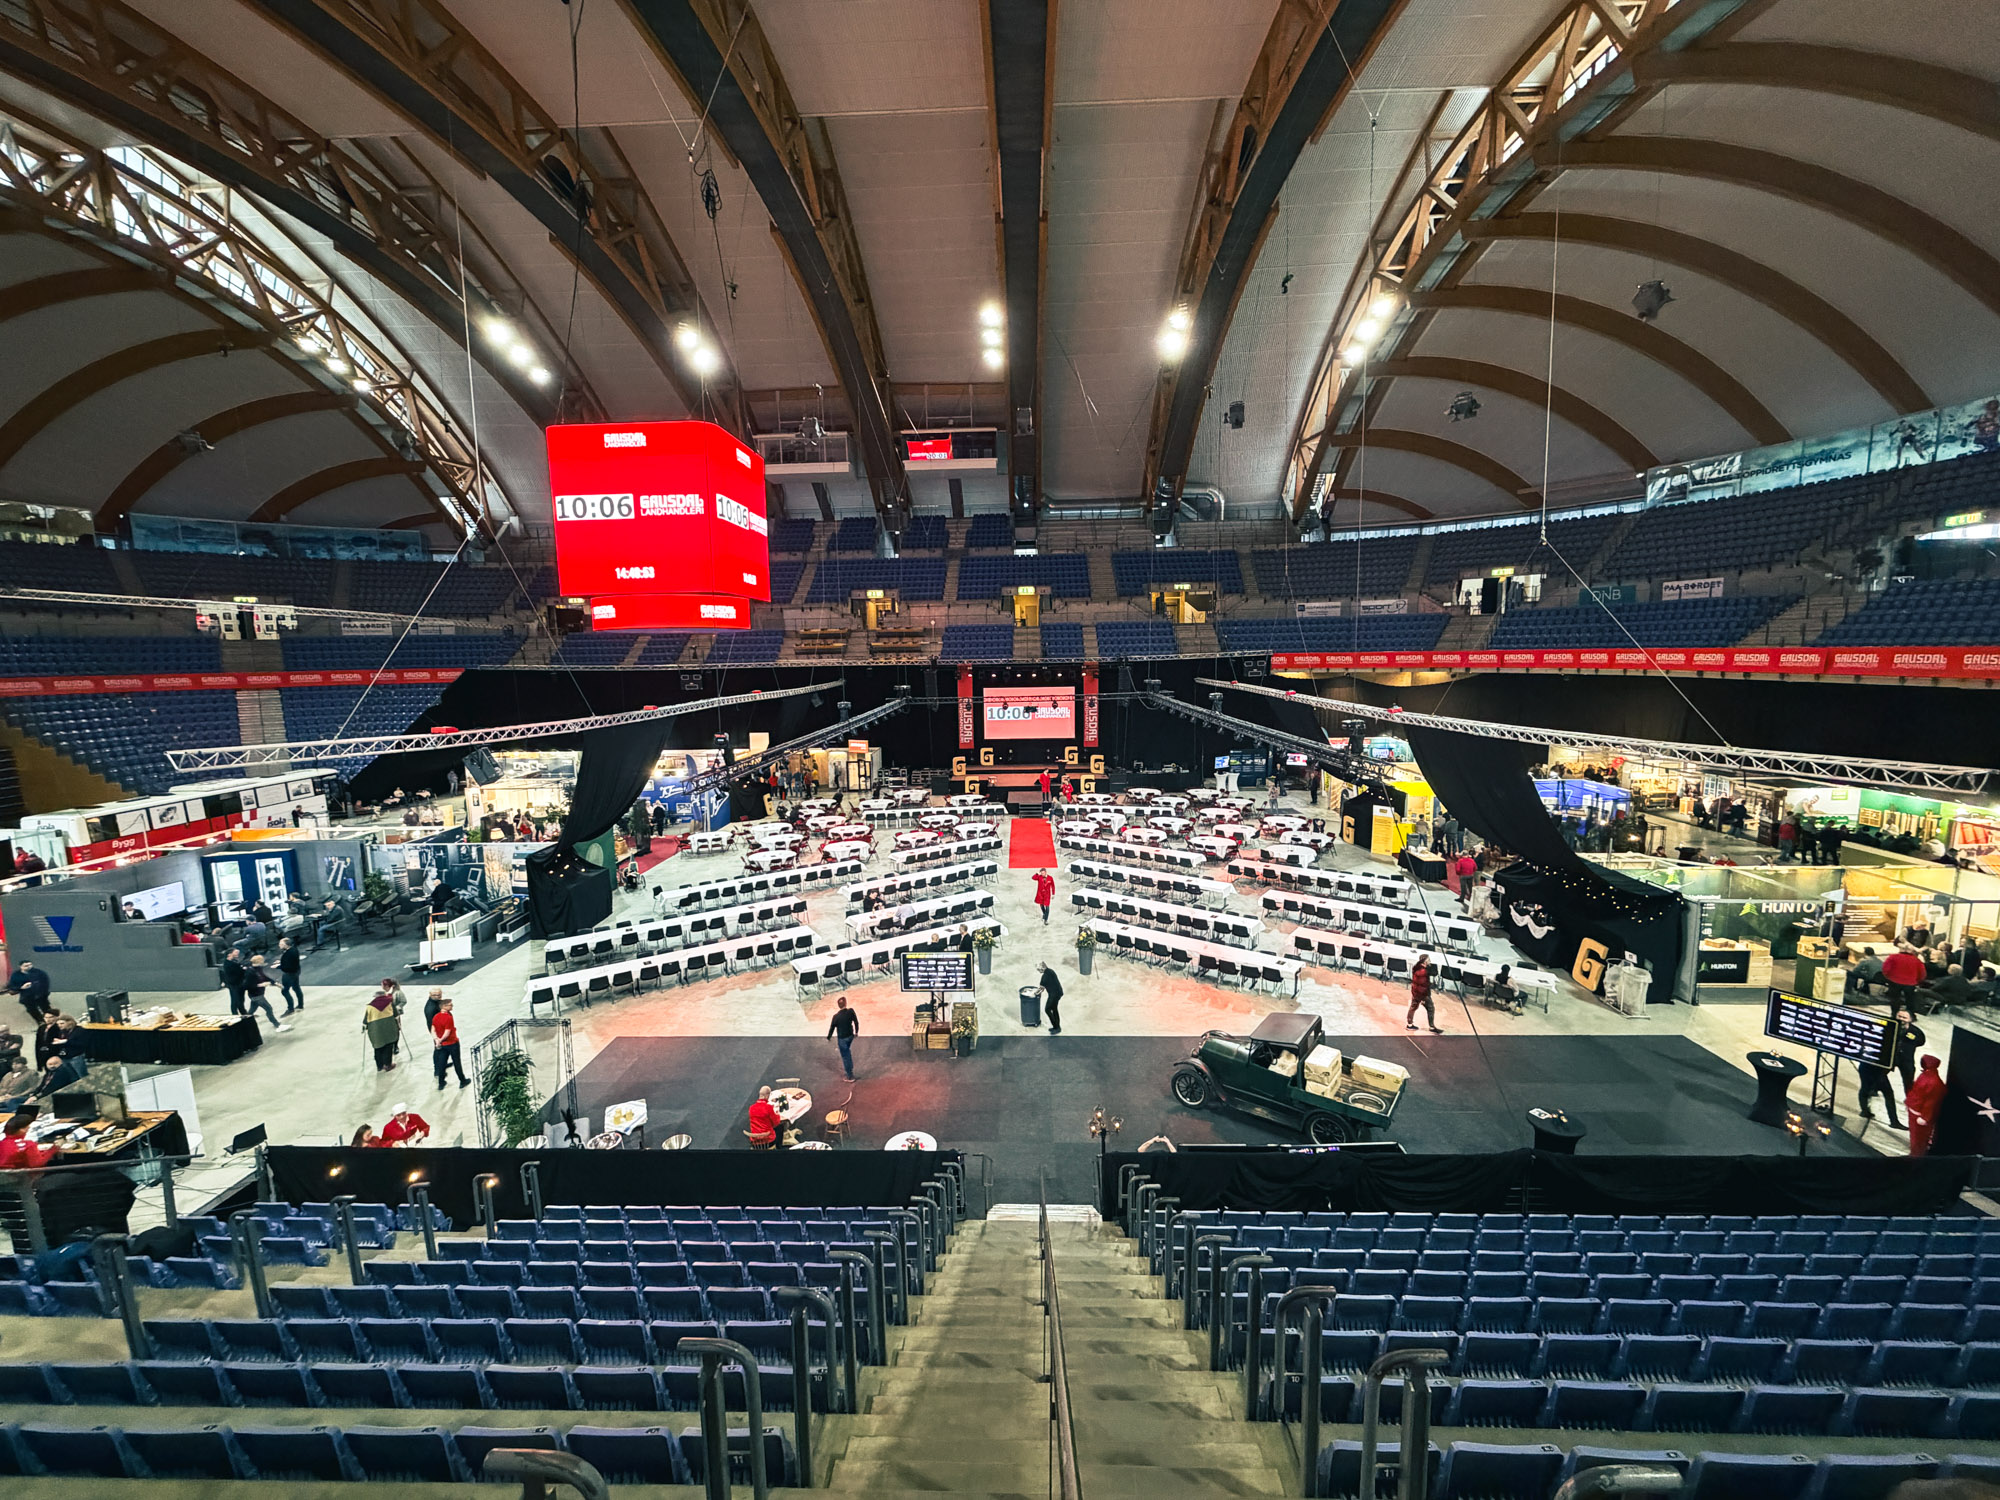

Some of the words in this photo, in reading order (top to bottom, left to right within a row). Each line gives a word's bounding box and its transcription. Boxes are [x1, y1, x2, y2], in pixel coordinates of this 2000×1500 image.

[557, 496, 632, 519] 10:06
[640, 494, 704, 509] GAUSDAL
[717, 496, 748, 528] 10:06
[1592, 586, 1621, 604] DNB
[1655, 653, 1686, 661] GAUSDAL
[1733, 653, 1770, 662] GAUSDAL
[1780, 653, 1821, 663] GAUSDAL
[1834, 653, 1880, 663] GAUSDAL
[1893, 653, 1948, 664] GAUSDAL
[1963, 654, 2000, 665] GAUS
[988, 707, 1031, 720] 10:06
[980, 747, 994, 766] G
[1064, 746, 1078, 764] G
[1090, 754, 1105, 774] G
[952, 756, 967, 776] G
[964, 776, 980, 794] G
[1080, 774, 1095, 794] G
[1343, 815, 1356, 845] G
[112, 838, 136, 849] Bygg
[1761, 902, 1816, 914] HUNTO
[1572, 937, 1609, 992] G
